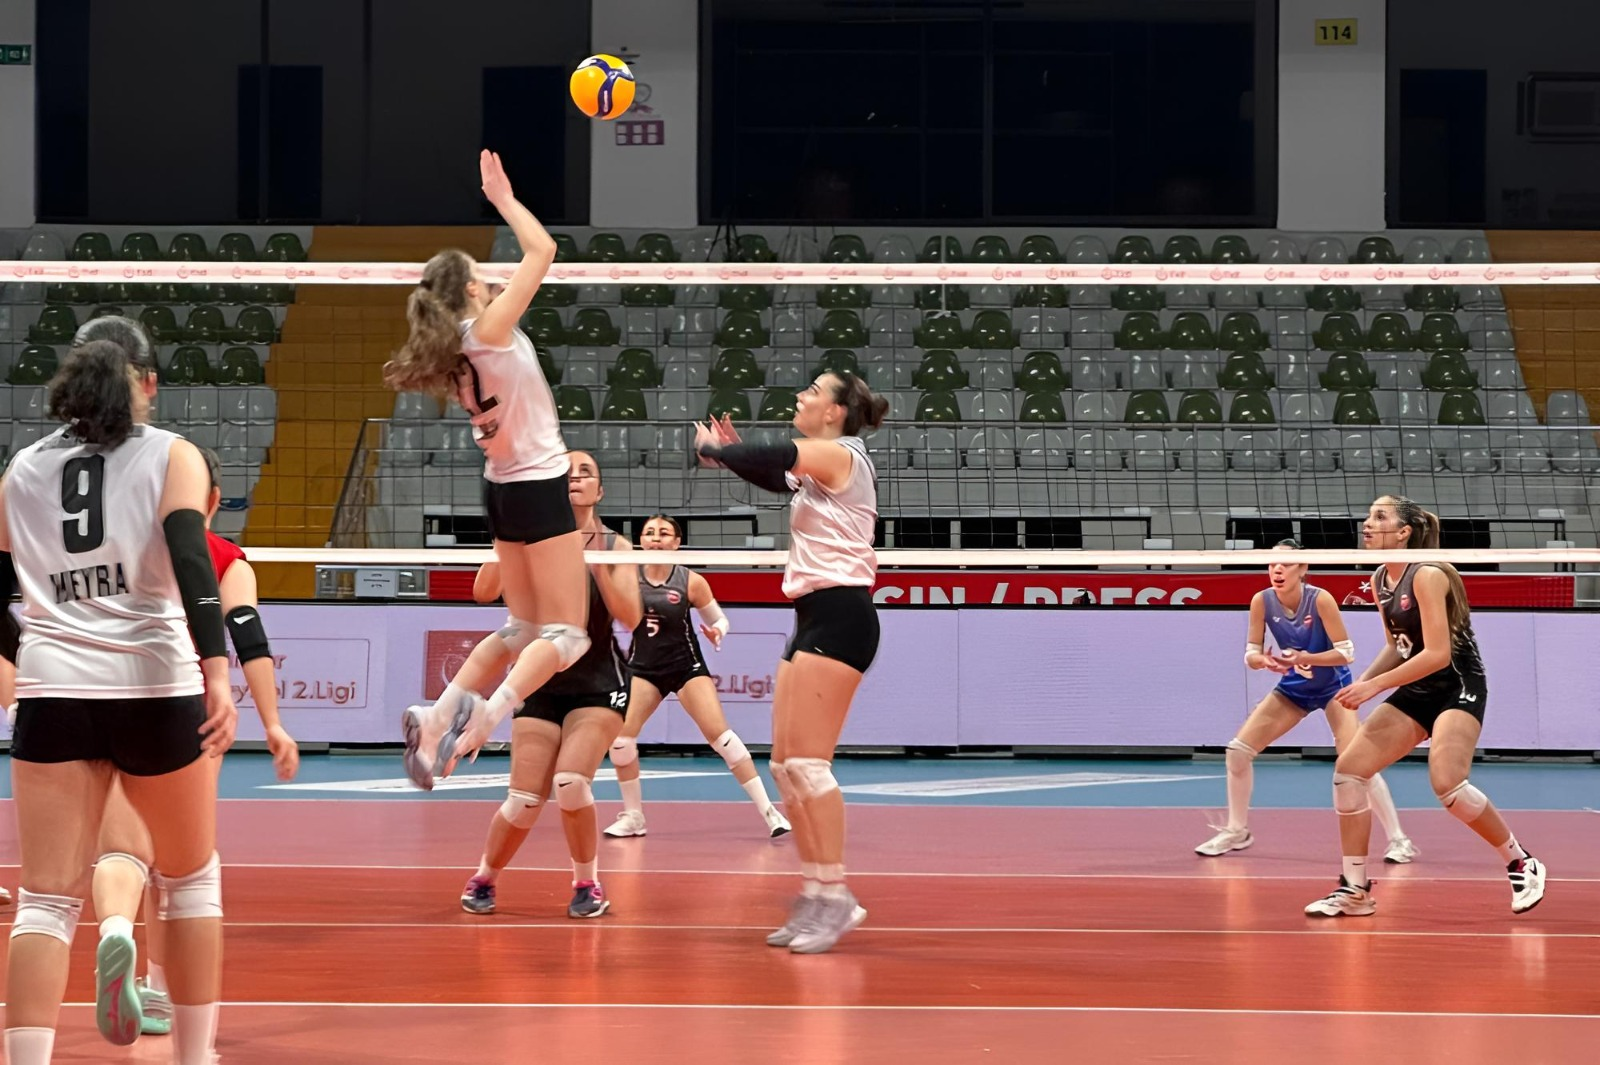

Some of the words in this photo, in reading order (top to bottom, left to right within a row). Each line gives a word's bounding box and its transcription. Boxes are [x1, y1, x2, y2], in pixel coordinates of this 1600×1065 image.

[1319, 25, 1352, 40] 114
[61, 453, 105, 554] 9
[49, 562, 130, 604] MEYRA
[646, 618, 660, 637] 5
[292, 680, 356, 704] 2.Ligi
[609, 690, 628, 708] 12
